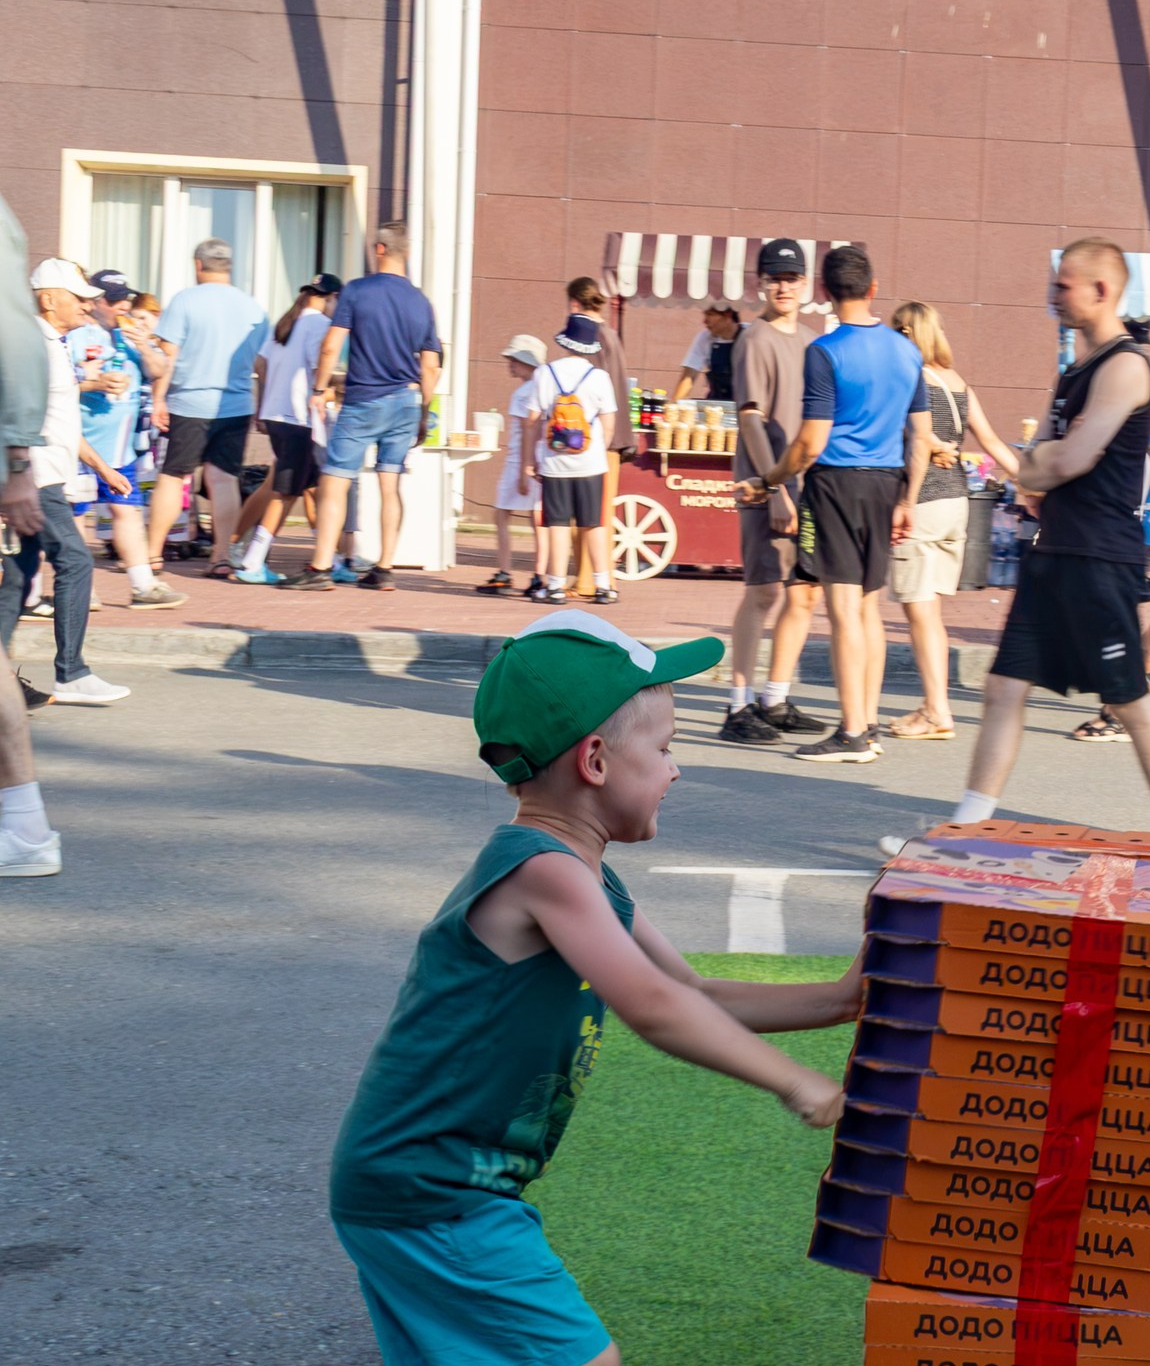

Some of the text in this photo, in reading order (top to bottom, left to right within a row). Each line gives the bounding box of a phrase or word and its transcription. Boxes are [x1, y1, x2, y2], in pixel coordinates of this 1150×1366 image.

[983, 919, 1073, 949] ДОДО
[980, 962, 1069, 992] ДОДО
[959, 1092, 1049, 1123] ДОДО
[950, 1135, 1039, 1165] ДОДО
[946, 1173, 1036, 1203] ДОДО
[930, 1212, 1019, 1243] ДОДО
[924, 1255, 1013, 1286] ДОДО
[914, 1314, 1003, 1341] ДОДО
